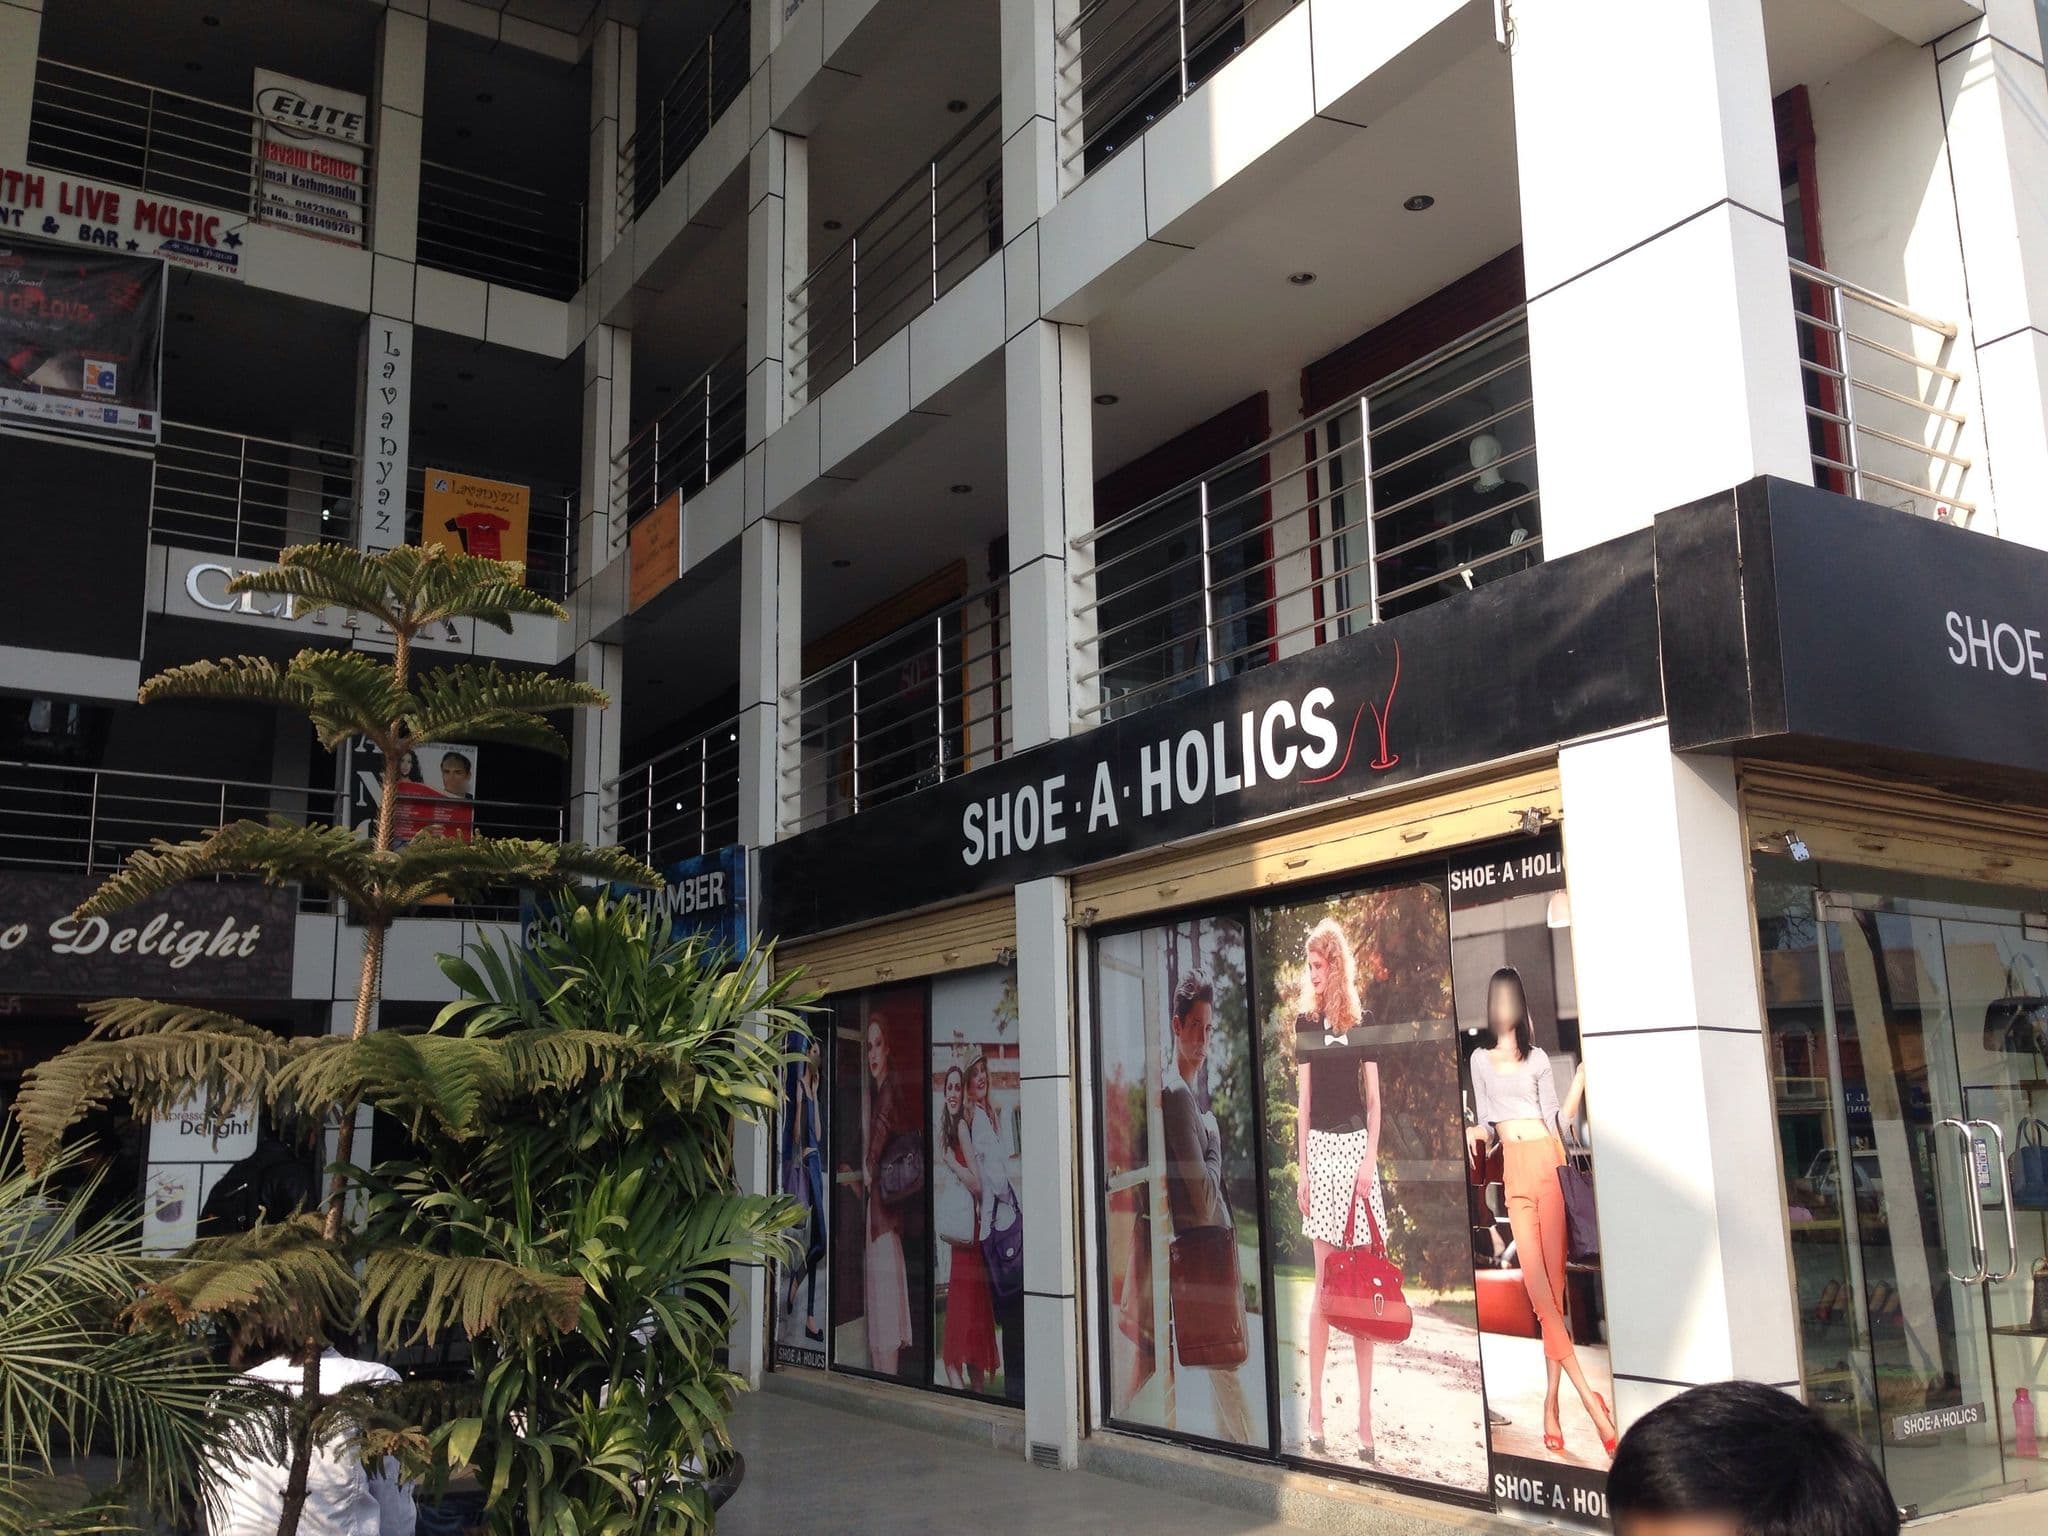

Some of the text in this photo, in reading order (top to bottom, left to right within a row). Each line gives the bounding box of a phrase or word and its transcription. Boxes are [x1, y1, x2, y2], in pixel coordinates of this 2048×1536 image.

[272, 95, 363, 130] ELITE
[311, 151, 359, 181] Center
[292, 173, 356, 201] Kathmandu
[59, 181, 120, 226] LIVE
[134, 198, 220, 247] MUSIC
[42, 215, 60, 234] &
[79, 223, 119, 248] BAR
[1946, 611, 2047, 681] SHOE
[1521, 851, 1565, 879] HOLI
[48, 912, 261, 969] Delight
[180, 1120, 248, 1139] Delght
